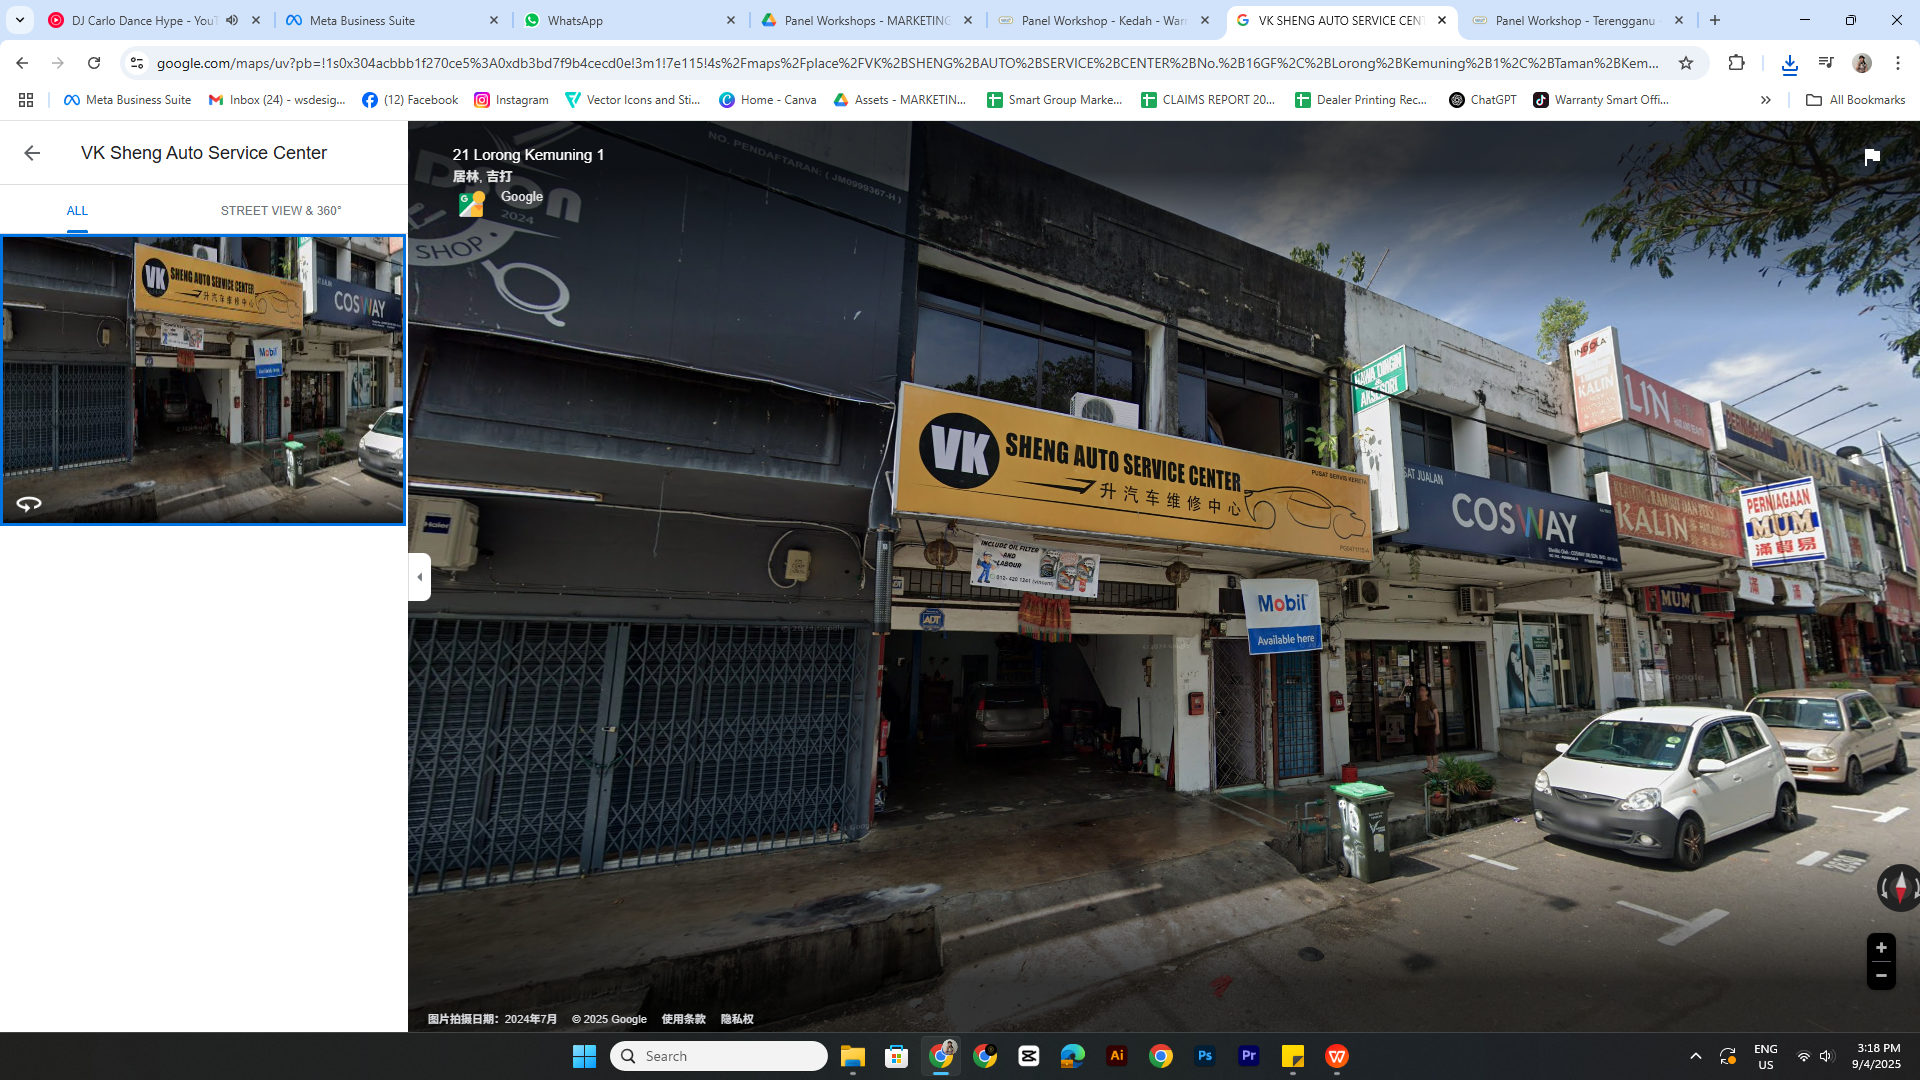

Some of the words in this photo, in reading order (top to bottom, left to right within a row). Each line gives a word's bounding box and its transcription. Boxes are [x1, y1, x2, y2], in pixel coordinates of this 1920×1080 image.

[72, 15, 85, 26] DJ
[87, 15, 116, 26] Carlo
[119, 15, 153, 26] Dance
[155, 15, 184, 29] Hype
[310, 15, 338, 26] Meta
[340, 15, 386, 26] Business
[388, 15, 416, 26] Suite
[547, 15, 604, 29] WhatsApp
[785, 15, 814, 26] Panel
[816, 15, 876, 29] Workshops
[1022, 15, 1051, 26] Panel
[1053, 15, 1108, 29] Workshop
[1119, 15, 1153, 26] Kedah
[1258, 15, 1275, 26] VK
[1276, 15, 1315, 26] SHENG
[1317, 15, 1350, 26] AUTO
[1351, 15, 1397, 26] SERVICE
[1496, 15, 1525, 26] Panel
[1527, 15, 1582, 29] Workshop
[1592, 15, 1655, 29] Terengganu
[86, 94, 114, 105] Meta
[116, 94, 162, 105] Business
[164, 94, 192, 105] Suite
[230, 94, 261, 105] Inbox
[262, 94, 284, 107] (24)
[383, 94, 405, 107] (12)
[407, 94, 459, 105] Facebook
[496, 94, 549, 108] Instagram
[586, 94, 622, 105] Vector
[624, 94, 653, 105] Icons
[654, 94, 676, 105] and
[741, 94, 774, 105] Home
[784, 94, 817, 105] Canva
[854, 94, 889, 105] Assets
[1008, 94, 1041, 105] Smart
[1042, 94, 1077, 108] Group
[1162, 94, 1205, 105] CLAIMS
[1208, 94, 1251, 105] REPORT
[1317, 94, 1353, 105] Dealer
[1354, 94, 1396, 108] Printing
[1470, 94, 1518, 105] ChatGPT
[1554, 94, 1604, 108] Warranty
[1606, 94, 1639, 105] Smart
[1829, 94, 1844, 105] All
[1847, 94, 1906, 105] Bookmarks
[80, 145, 106, 160] VK
[109, 145, 162, 164] Sheng
[165, 145, 204, 160] Auto
[207, 145, 269, 160] Service
[272, 145, 329, 160] Center
[707, 130, 731, 145] NO.
[733, 139, 823, 176] PENDAFTARAN:
[66, 205, 89, 216] ALL
[220, 205, 269, 216] STREET
[270, 205, 303, 216] VIEW
[304, 205, 314, 216] &
[415, 236, 484, 260] SHOP
[144, 264, 167, 291] VK
[170, 266, 194, 283] SHENG
[193, 273, 211, 288] AUTO
[211, 277, 235, 291] SERVICE
[234, 281, 255, 295] CENTER
[334, 290, 386, 318] COSWAY
[259, 347, 278, 357] Mobil
[1574, 337, 1607, 357] INDOLA
[1577, 374, 1614, 399] KALIN
[930, 424, 991, 477] VK
[1005, 431, 1069, 465] SHENG
[1073, 442, 1119, 473] AUTO
[1122, 452, 1185, 485] SERVICE
[1187, 463, 1242, 493] CENTER
[1416, 469, 1444, 486] JUALAN
[1098, 481, 1243, 518] 升汽车维修中心
[1746, 487, 1811, 515] PERNIAGAAN
[424, 521, 450, 529] Haier
[1452, 492, 1577, 545] COSWAY
[1615, 500, 1689, 542] KALIN
[1749, 508, 1816, 541] MUM
[980, 540, 1008, 549] INCLUDE
[1008, 543, 1019, 551] OIL
[1019, 545, 1040, 553] FILTER
[996, 560, 1022, 569] LABOUR
[1257, 593, 1307, 613] Mobil
[1660, 589, 1690, 608] MUM
[922, 615, 941, 625] ADT
[1257, 633, 1295, 647] Available
[1296, 633, 1315, 645] here
[1754, 1044, 1778, 1055] ENG
[1857, 1043, 1881, 1053] 3:18
[1883, 1043, 1901, 1053] PM
[645, 1050, 687, 1063] Search
[1758, 1060, 1774, 1070] US
[1852, 1059, 1902, 1070] 9/4/2025
